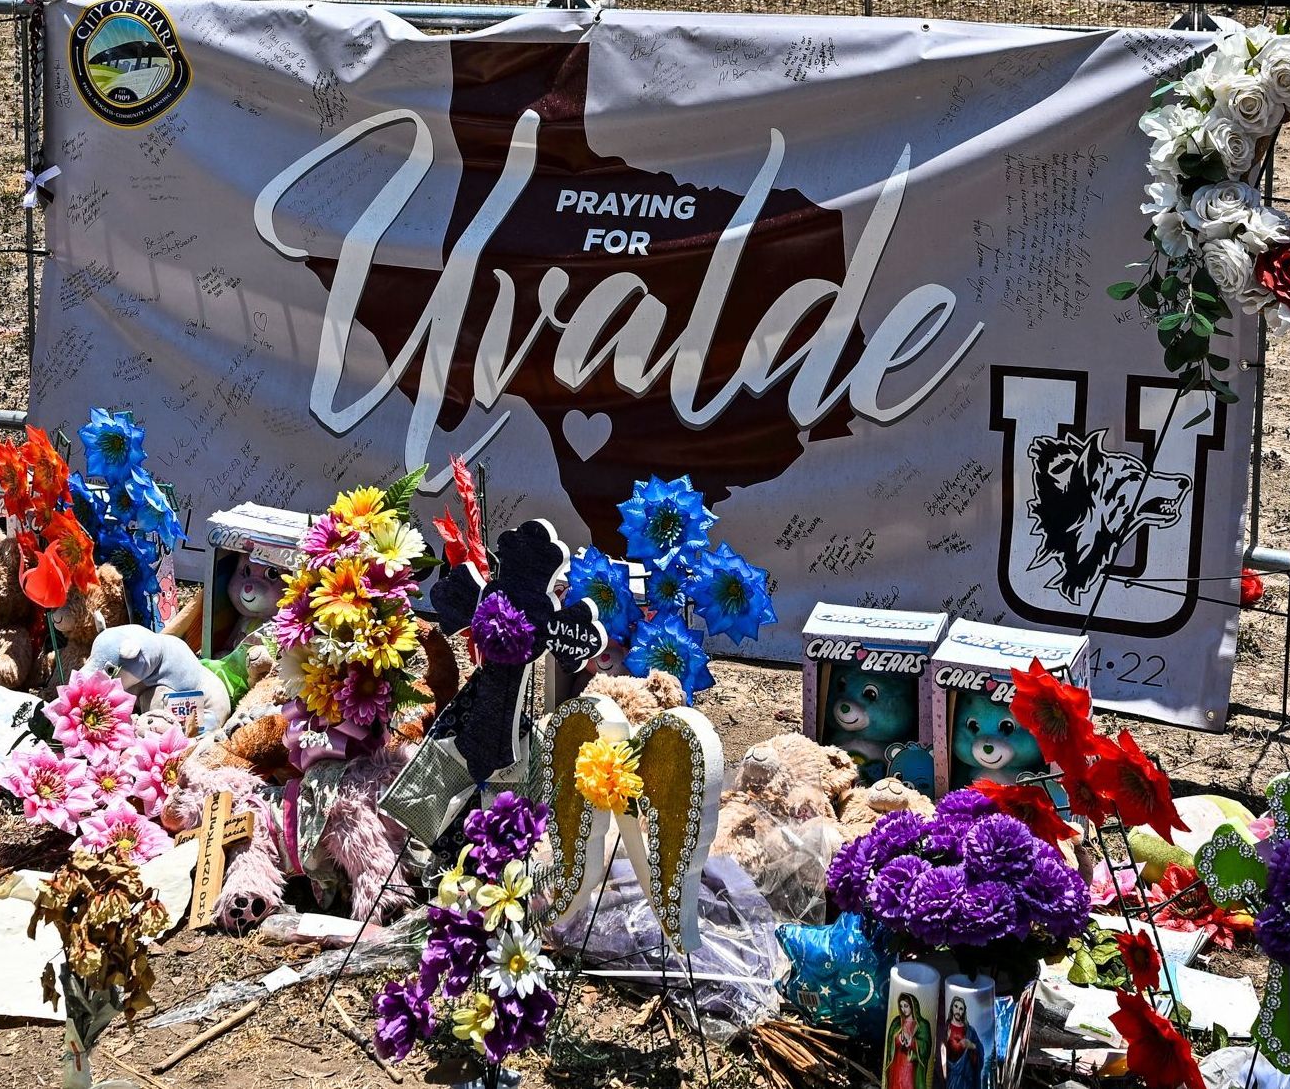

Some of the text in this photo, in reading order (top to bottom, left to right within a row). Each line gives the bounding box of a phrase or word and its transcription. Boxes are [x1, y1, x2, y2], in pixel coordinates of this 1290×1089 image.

[76, 0, 178, 57] CITY OF PHARR
[555, 189, 696, 221] PRAYING
[582, 229, 651, 257] FOR
[253, 108, 986, 496] Uvalde
[208, 526, 250, 549] CARE
[547, 620, 599, 647] Uvalde
[546, 638, 591, 661] strong
[806, 638, 929, 674] CARE BEARS
[935, 666, 989, 691] CARE
